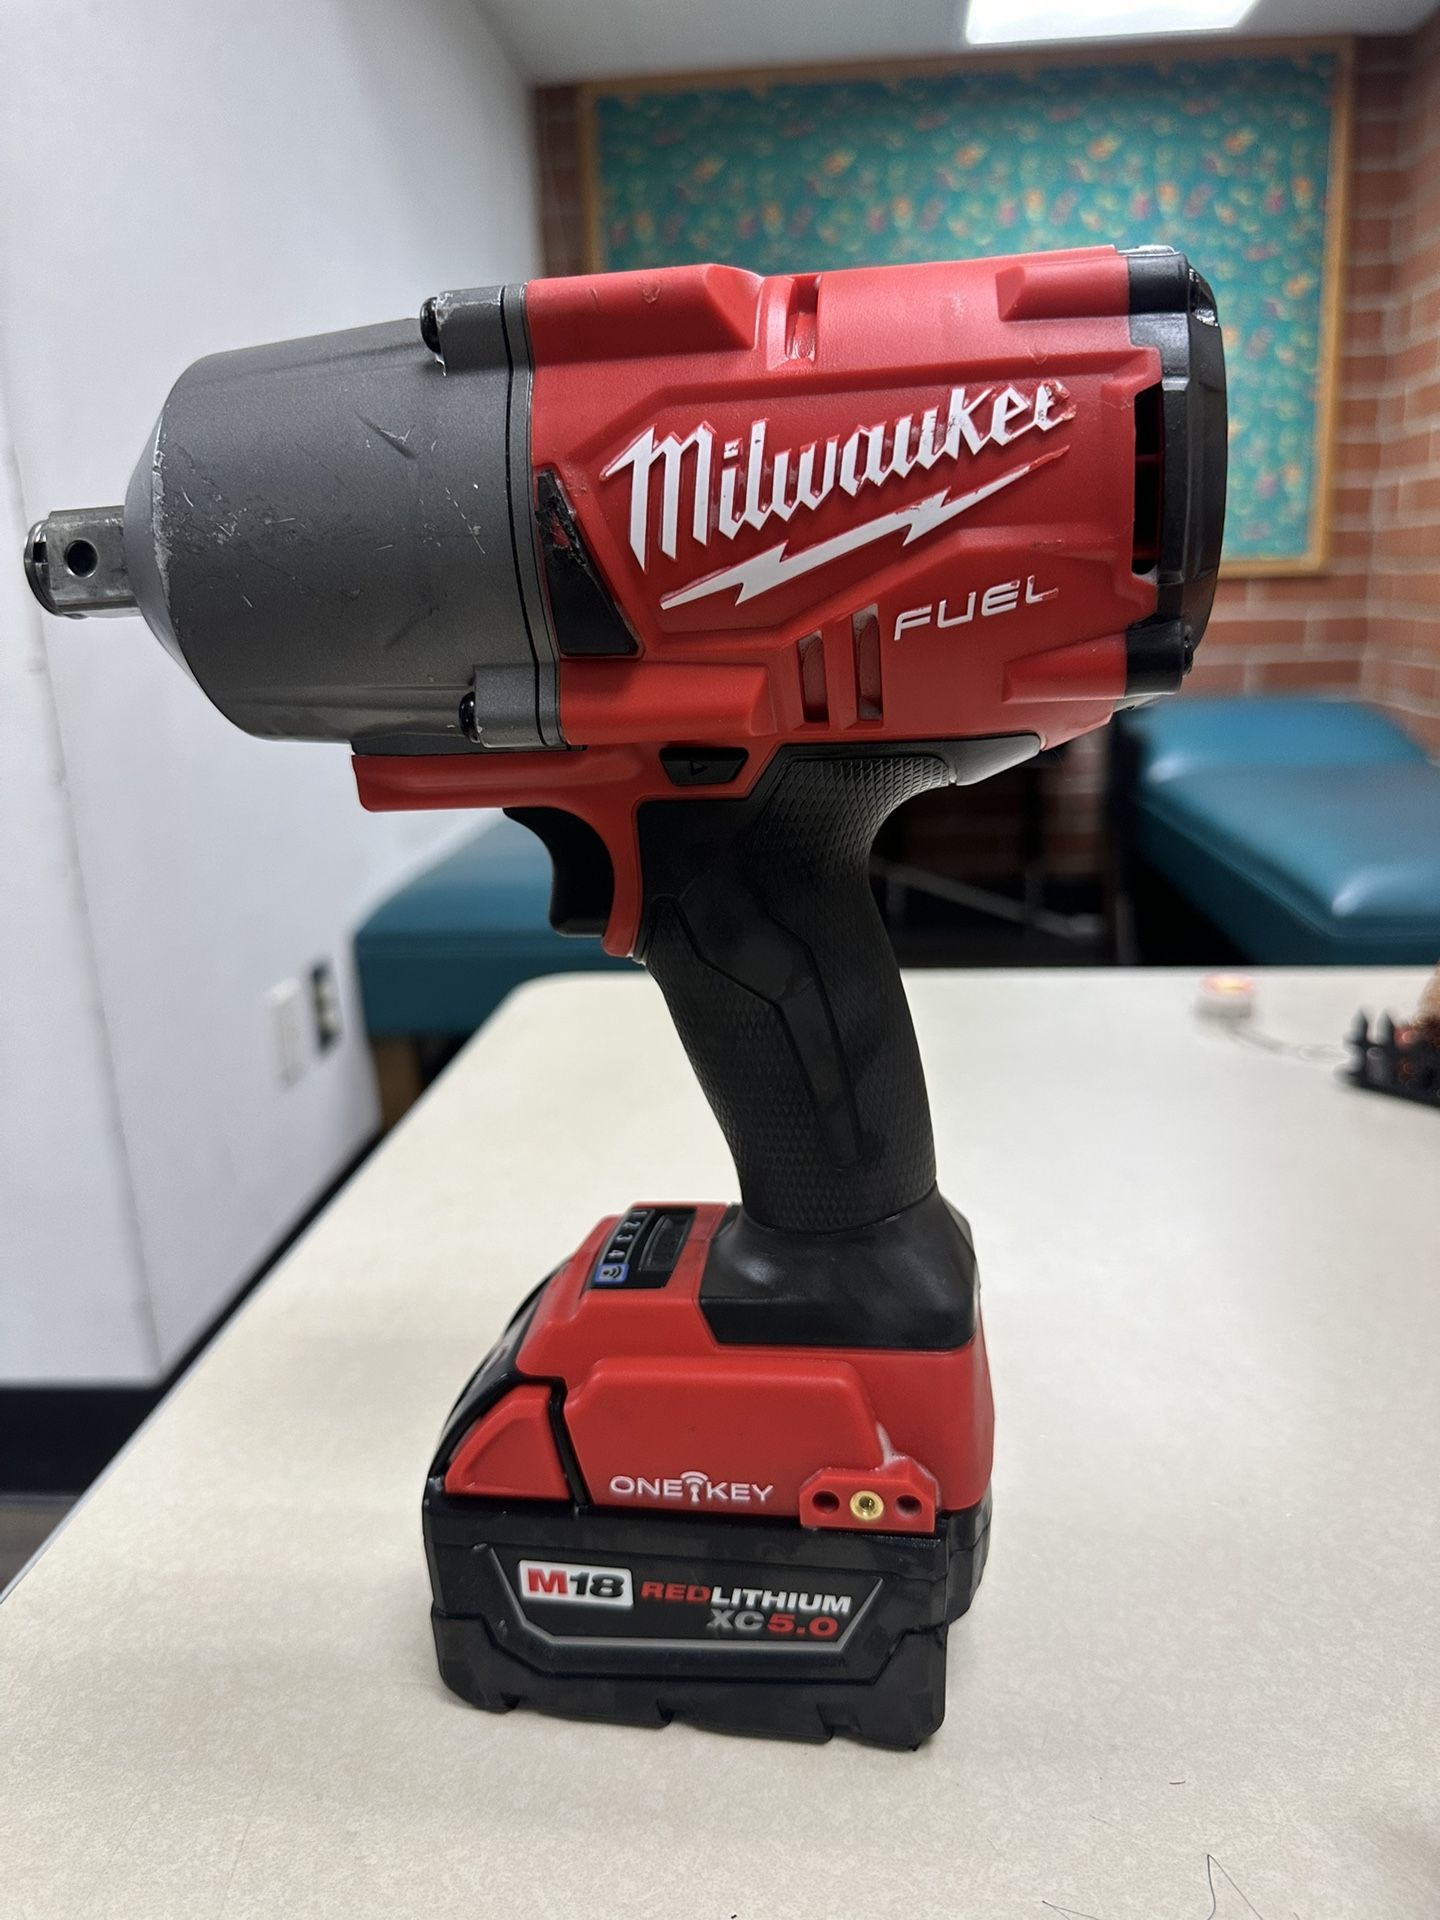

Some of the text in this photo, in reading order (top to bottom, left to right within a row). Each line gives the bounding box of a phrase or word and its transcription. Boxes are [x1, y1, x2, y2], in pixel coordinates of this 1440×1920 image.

[599, 380, 1077, 573] Milwaukee
[893, 575, 1059, 641] FUEL
[526, 1566, 626, 1599] M18
